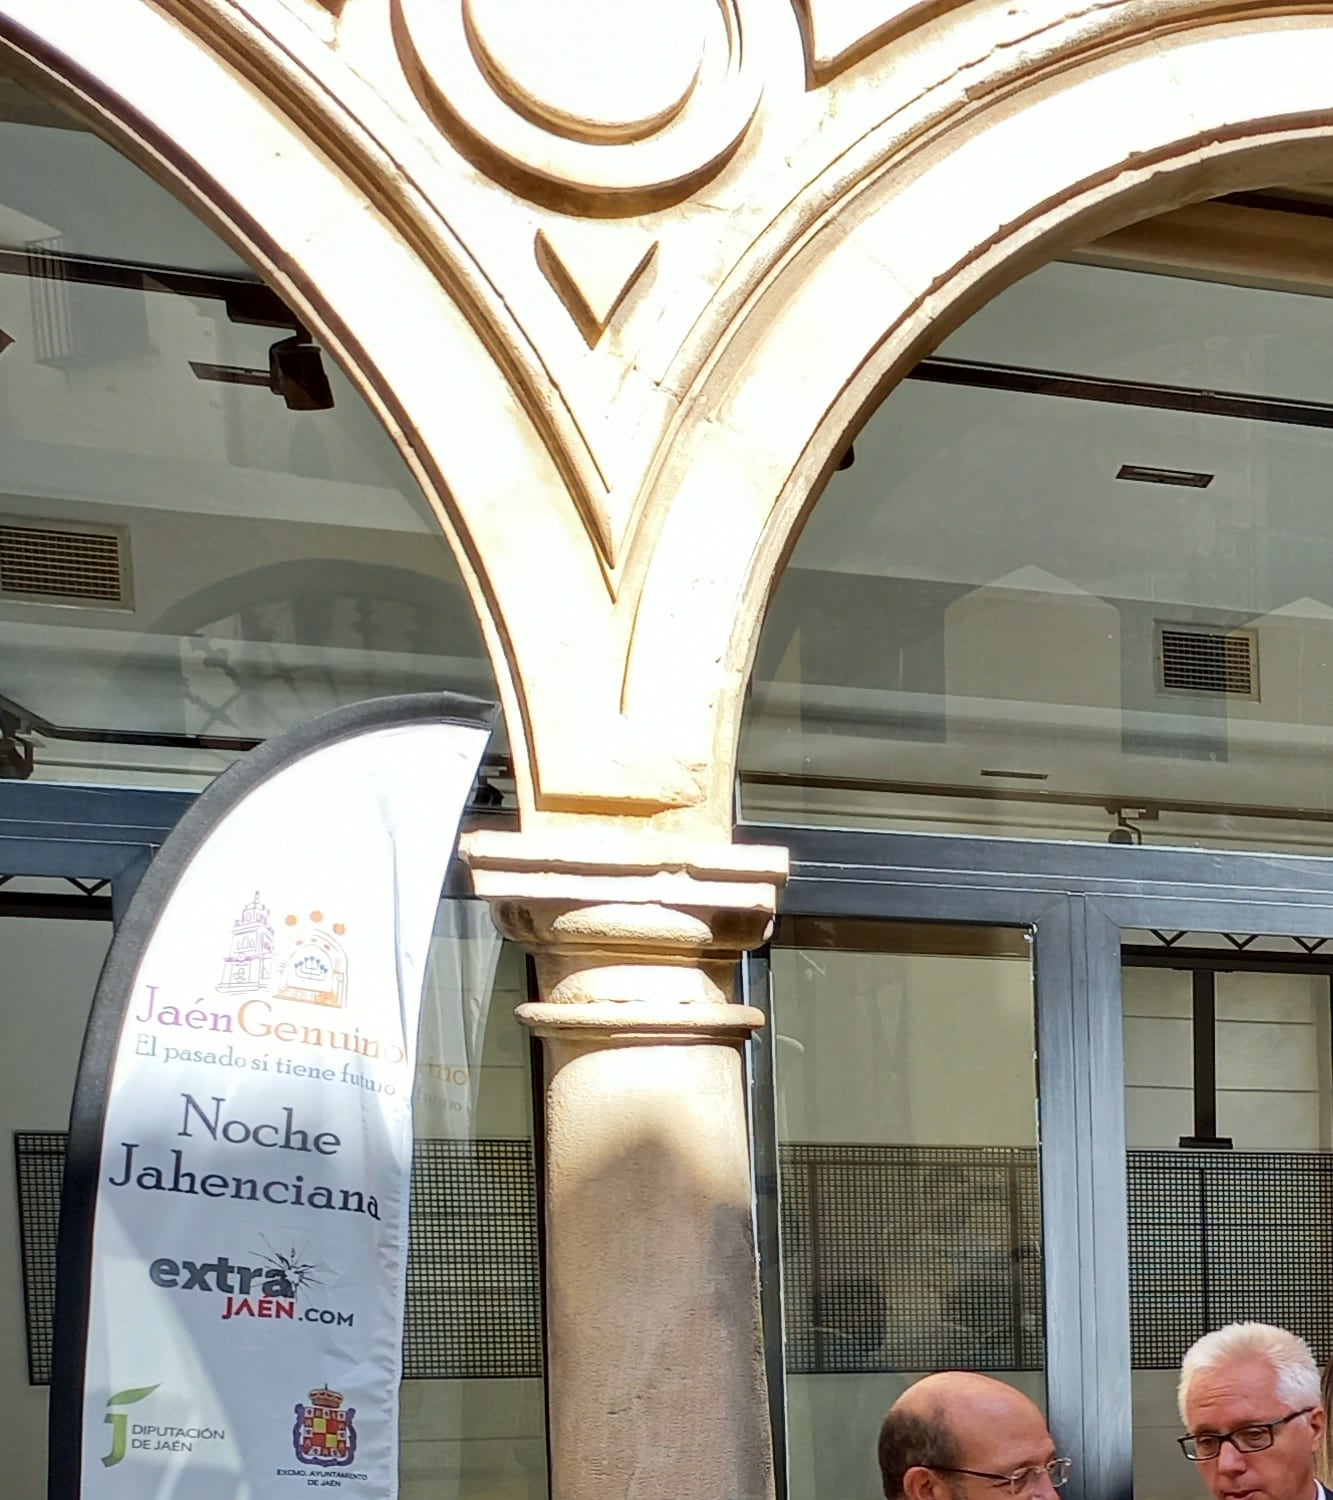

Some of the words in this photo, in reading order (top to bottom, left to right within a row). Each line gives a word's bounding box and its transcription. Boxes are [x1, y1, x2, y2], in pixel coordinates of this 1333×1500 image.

[135, 1033, 157, 1057] El
[163, 1045, 247, 1070] pasado
[251, 1054, 269, 1072] sí
[276, 1057, 336, 1082] tiene
[177, 1092, 341, 1155] Noche
[108, 1142, 382, 1221] Jahenciana
[150, 1257, 296, 1299] extra
[131, 1438, 151, 1450] DE
[155, 1440, 193, 1452] JAÉN
[132, 1424, 226, 1440] DIPUTACIÓN
